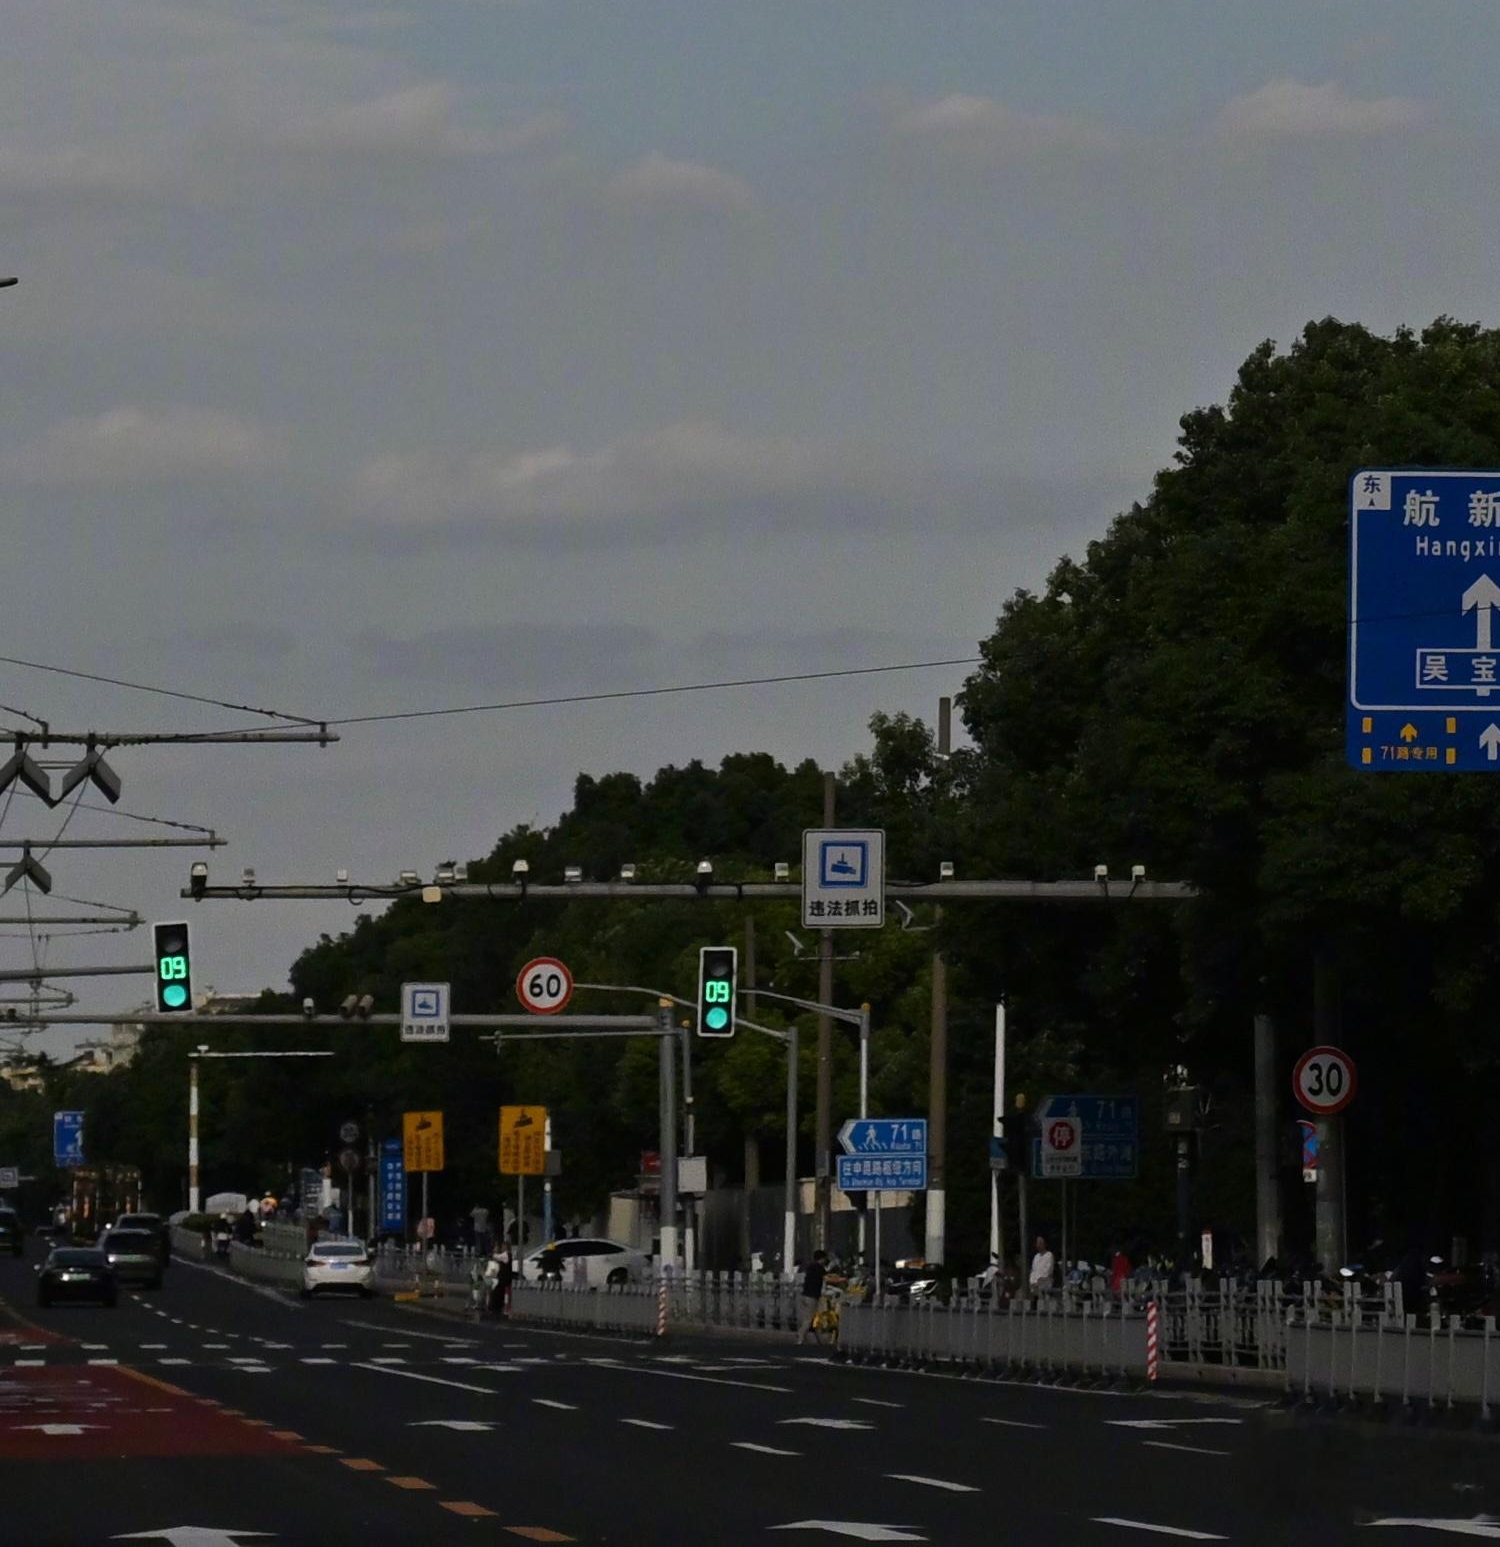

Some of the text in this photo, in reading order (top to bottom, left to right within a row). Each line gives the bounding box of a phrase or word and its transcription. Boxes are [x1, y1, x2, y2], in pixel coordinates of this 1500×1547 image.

[1363, 475, 1381, 494] 东
[809, 899, 878, 917] 违法抓拍
[160, 956, 186, 980] 09
[530, 974, 561, 997] 60
[705, 981, 730, 1003] 09
[1308, 1062, 1342, 1096] 30
